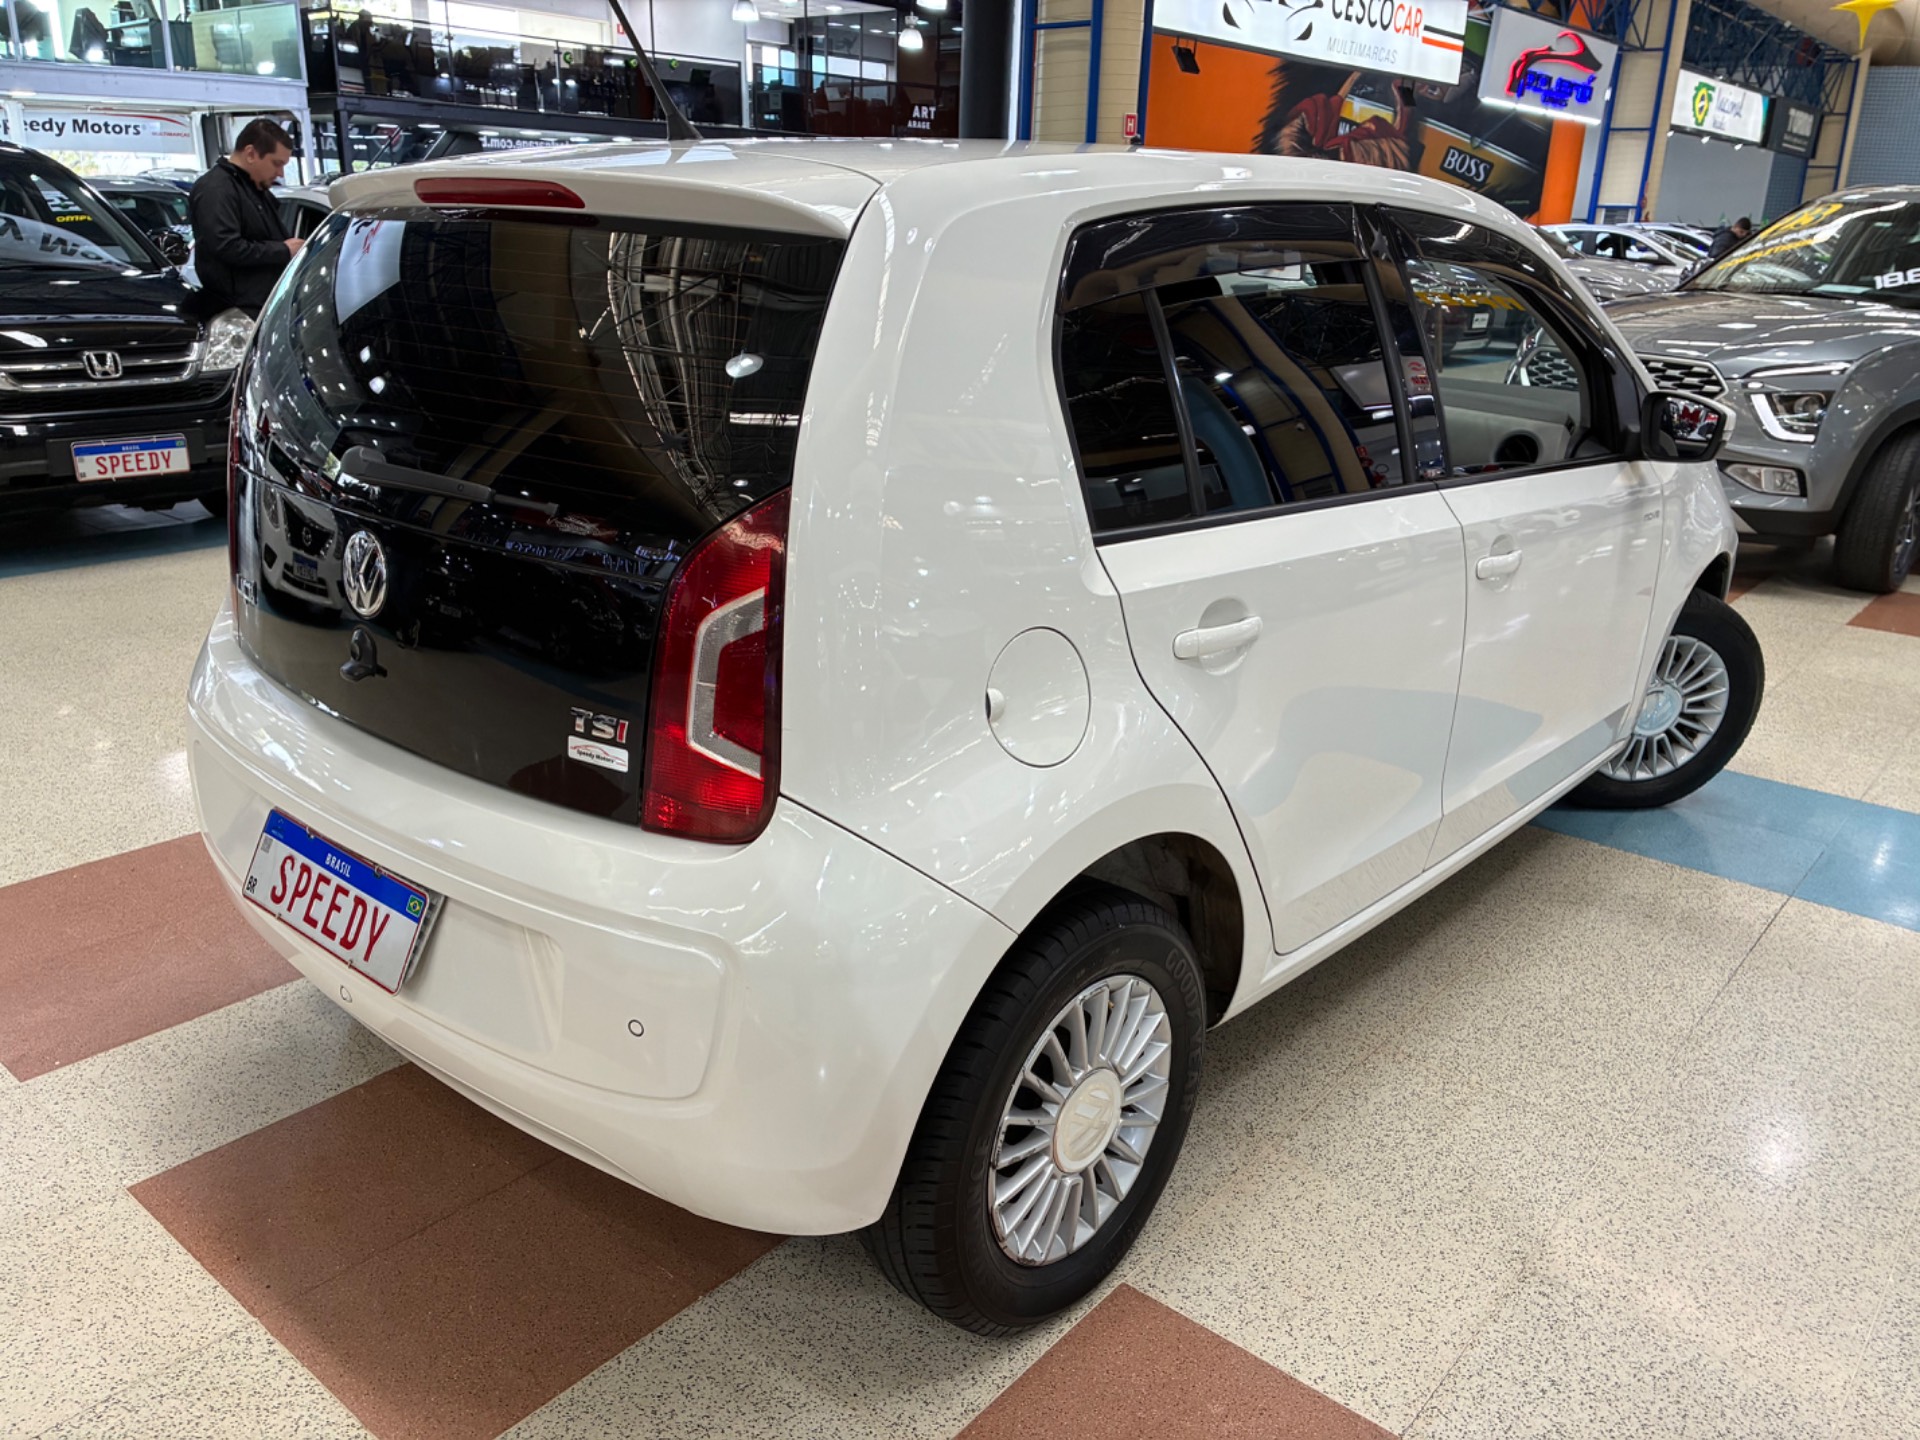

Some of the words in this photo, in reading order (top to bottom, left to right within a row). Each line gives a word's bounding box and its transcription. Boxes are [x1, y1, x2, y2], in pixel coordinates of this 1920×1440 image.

[1327, 37, 1398, 64] MULTIMARCAS
[912, 105, 936, 119] ART
[72, 118, 141, 136] Motors
[1443, 148, 1491, 183] BOSS
[95, 450, 172, 475] SPEEDY
[324, 852, 351, 878] BRASIL
[270, 855, 391, 962] SPEEDY
